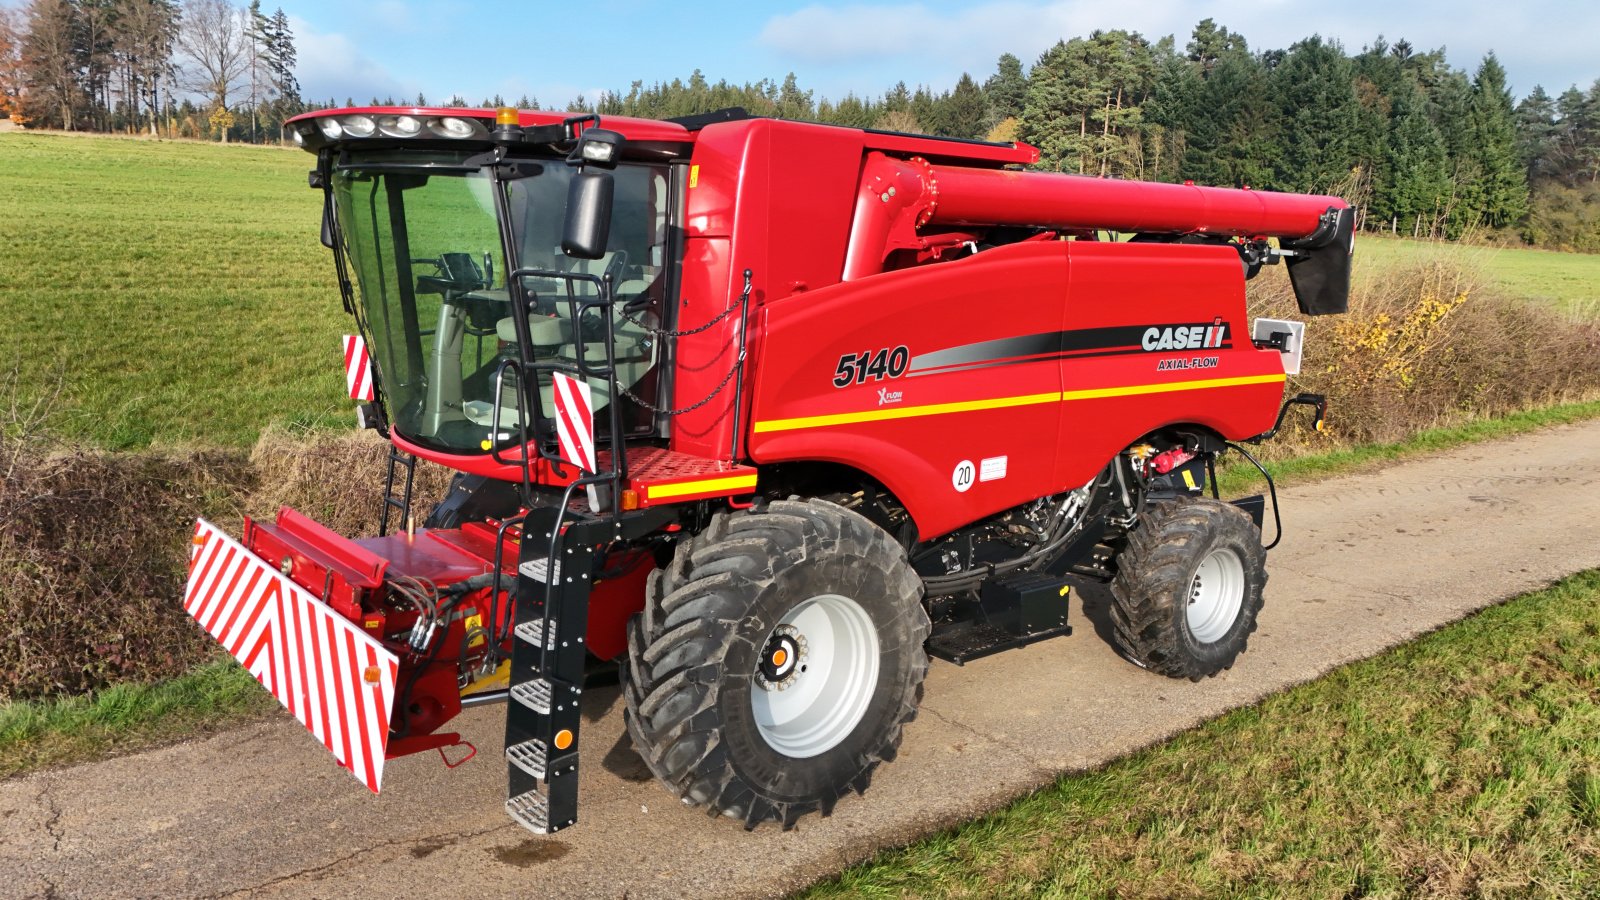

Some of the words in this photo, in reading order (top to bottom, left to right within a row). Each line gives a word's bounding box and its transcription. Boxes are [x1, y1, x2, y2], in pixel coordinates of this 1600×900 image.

[1142, 327, 1204, 351] CASE
[833, 345, 909, 388] 5140
[1157, 357, 1218, 371] AXIAL-FLOW
[958, 466, 971, 486] 20
